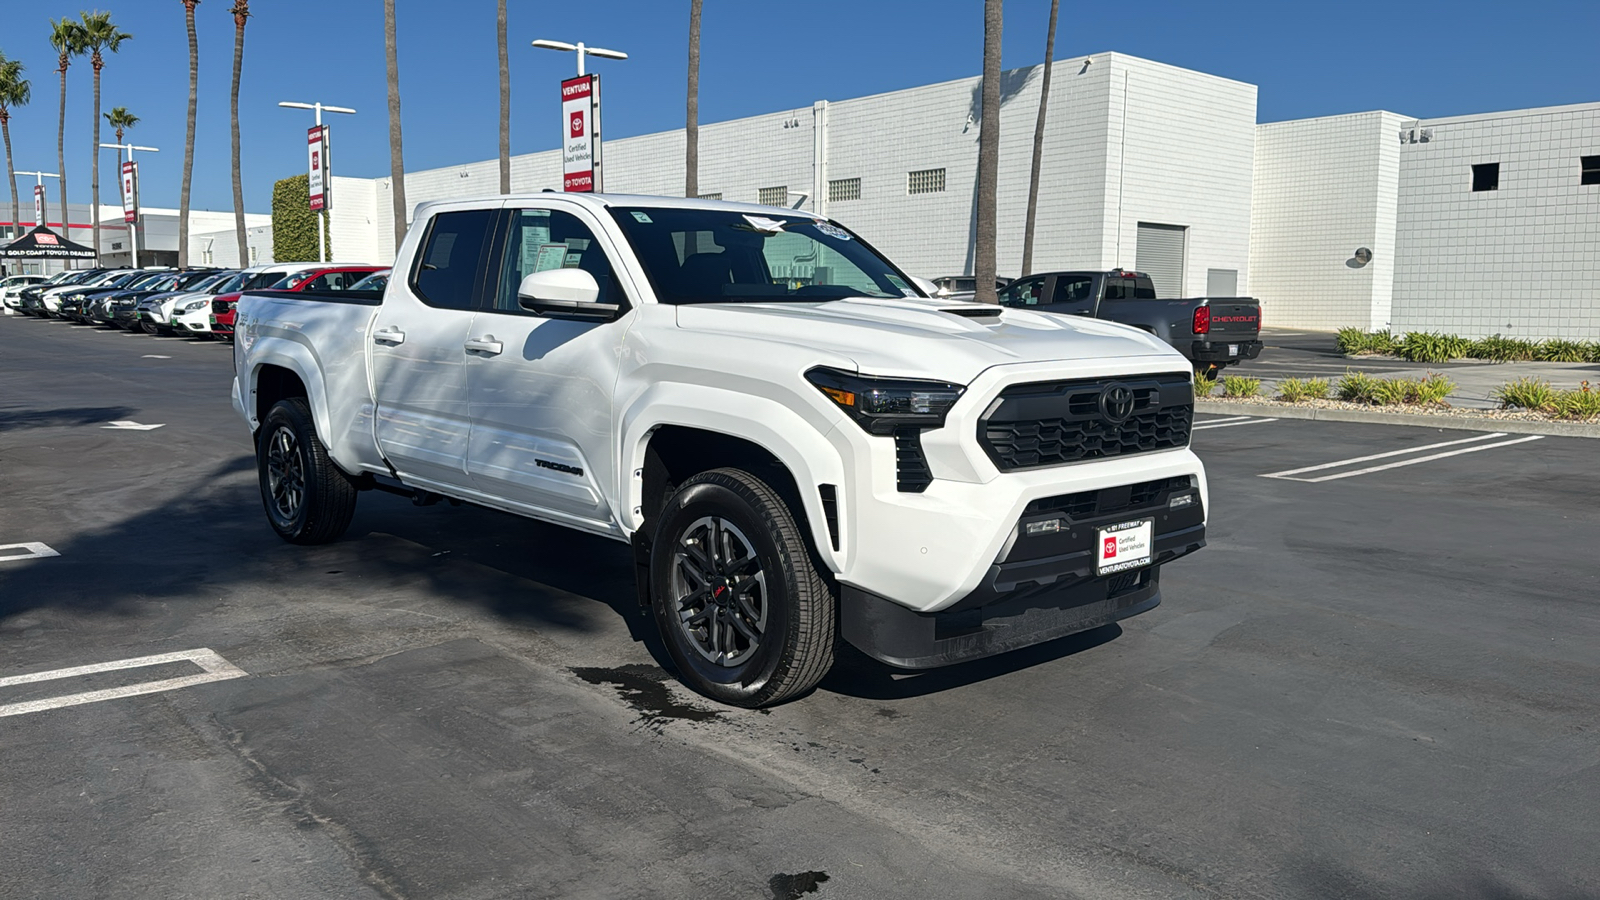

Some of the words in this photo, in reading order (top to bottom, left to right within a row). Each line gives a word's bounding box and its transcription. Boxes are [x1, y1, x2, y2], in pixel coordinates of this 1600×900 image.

[563, 82, 590, 96] VENTURA
[568, 142, 586, 153] Certified
[564, 154, 575, 163] Used
[575, 152, 591, 163] Vehicles
[571, 176, 592, 186] TOYOTA
[534, 458, 584, 477] TACOMA
[1118, 520, 1140, 530] FREEWAY
[1118, 535, 1136, 545] Certified
[1129, 542, 1145, 551] Vehicles
[1099, 557, 1151, 575] VENTURATOYOTA.COM
